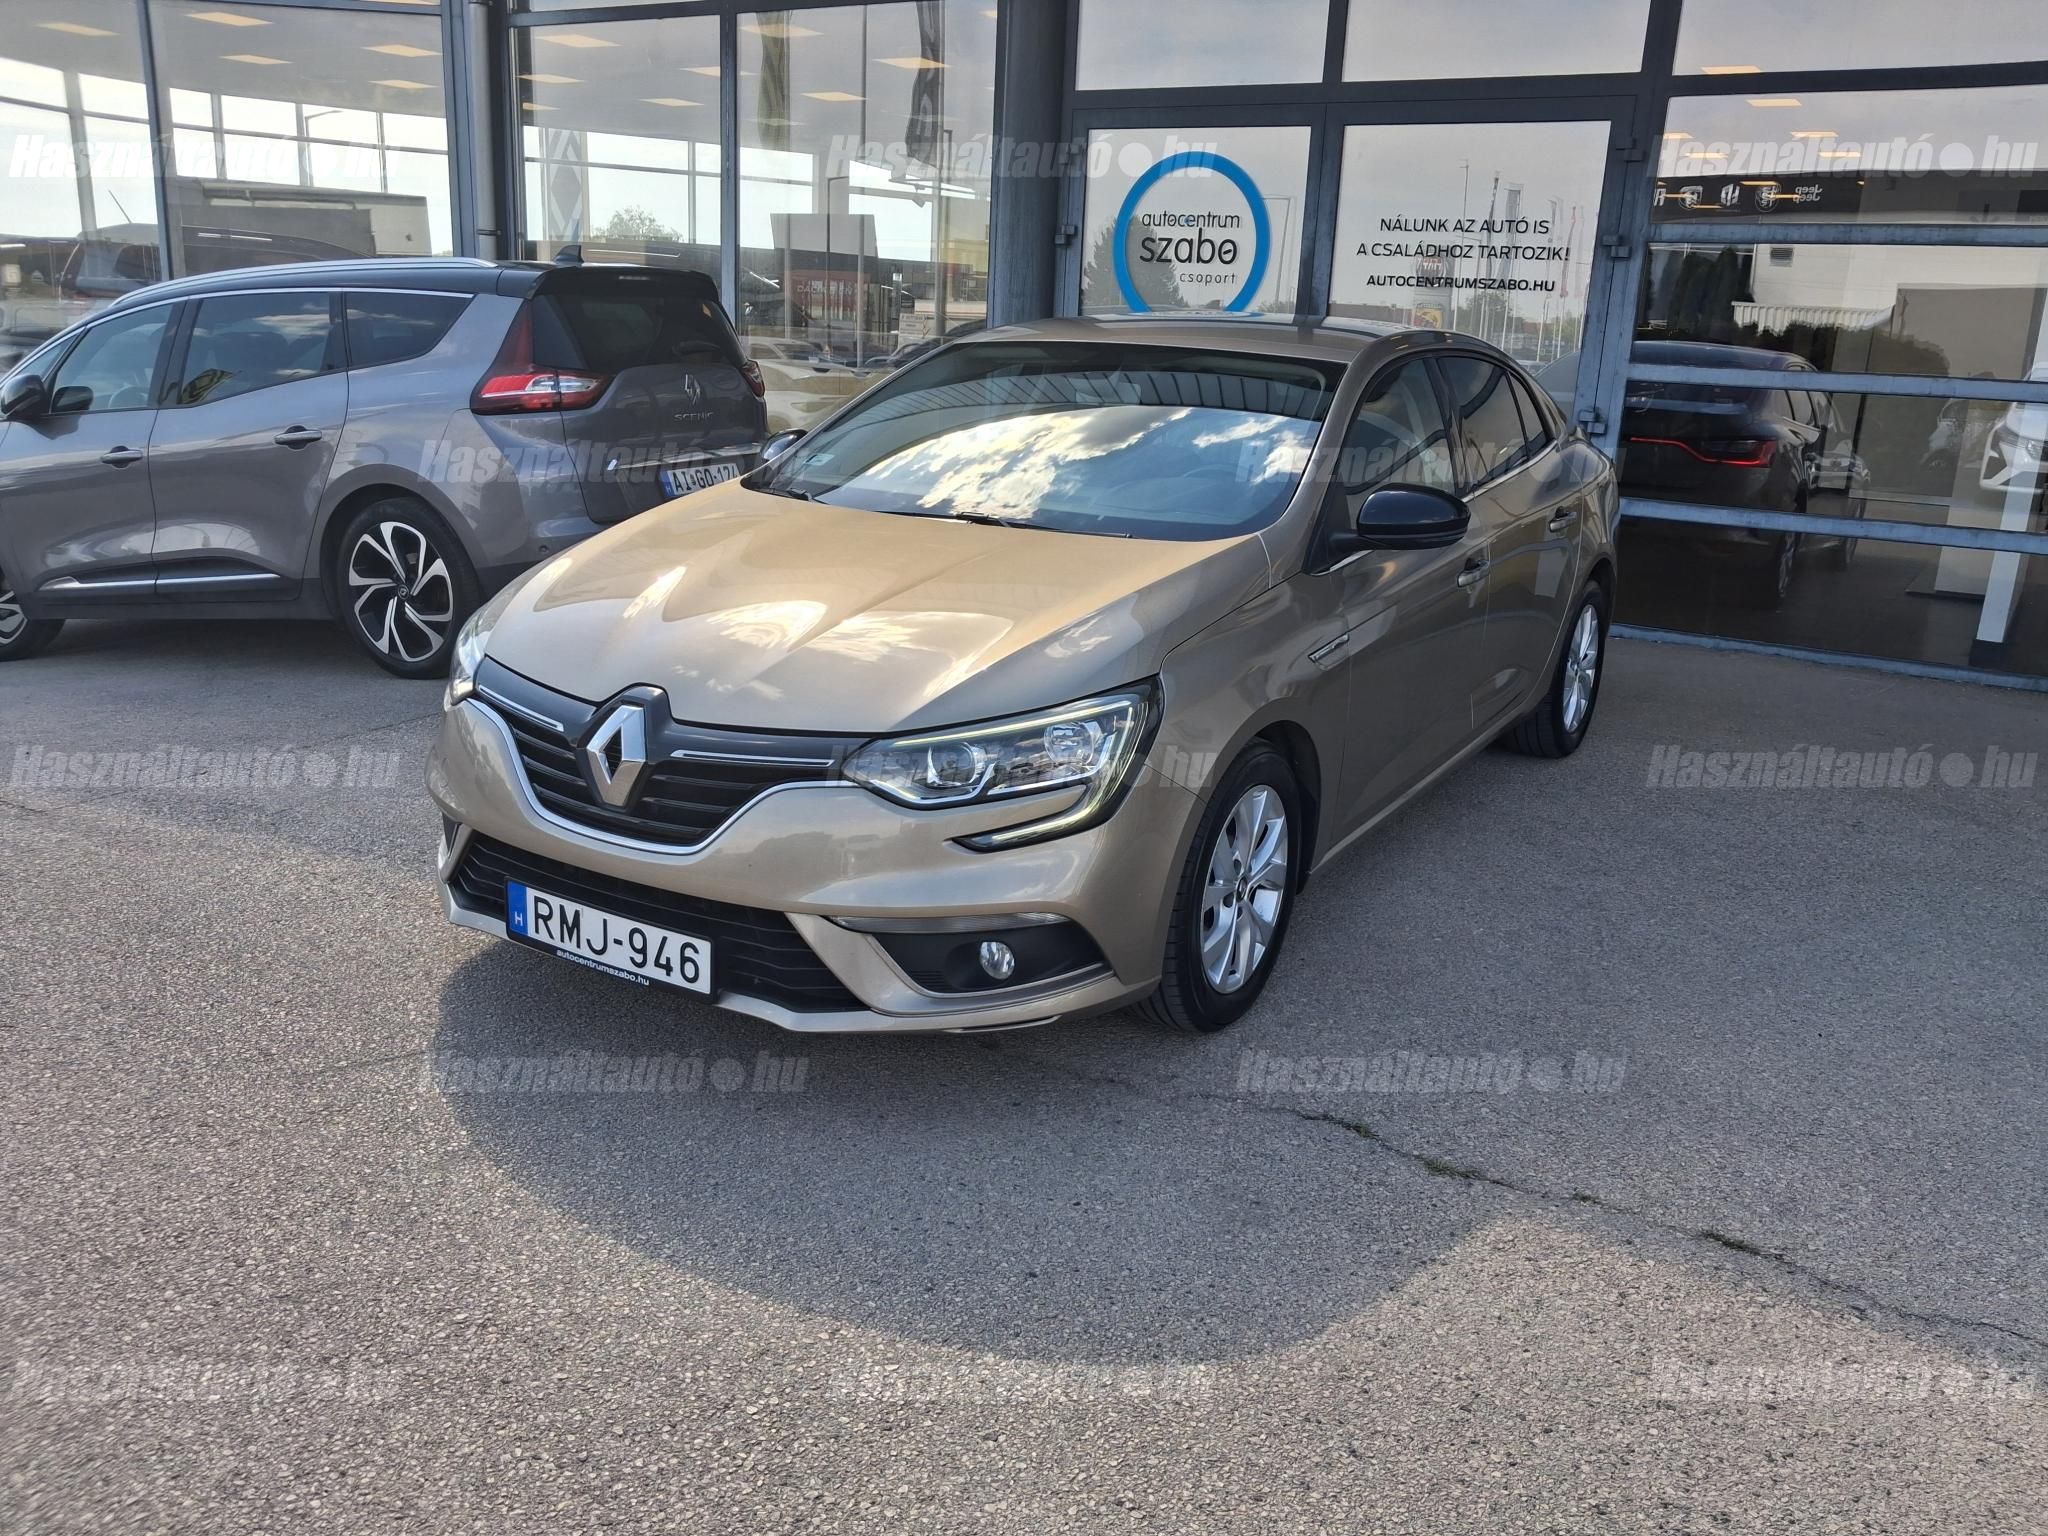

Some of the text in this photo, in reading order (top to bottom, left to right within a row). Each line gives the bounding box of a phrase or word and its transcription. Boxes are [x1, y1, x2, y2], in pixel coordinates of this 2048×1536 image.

[1141, 210, 1240, 228] autocentrum
[1380, 214, 1550, 234] NÁLUNK AZ AUTÓ IS
[1356, 240, 1569, 261] A CSALÁDHOZ TARTOZIK!
[1179, 272, 1236, 286] csoport
[1366, 275, 1555, 292] AUTOCENTRUMSZABO.HU
[514, 911, 523, 927] H
[534, 895, 700, 984] RMJ-946
[556, 949, 650, 986] autocentrumszabo.hu
